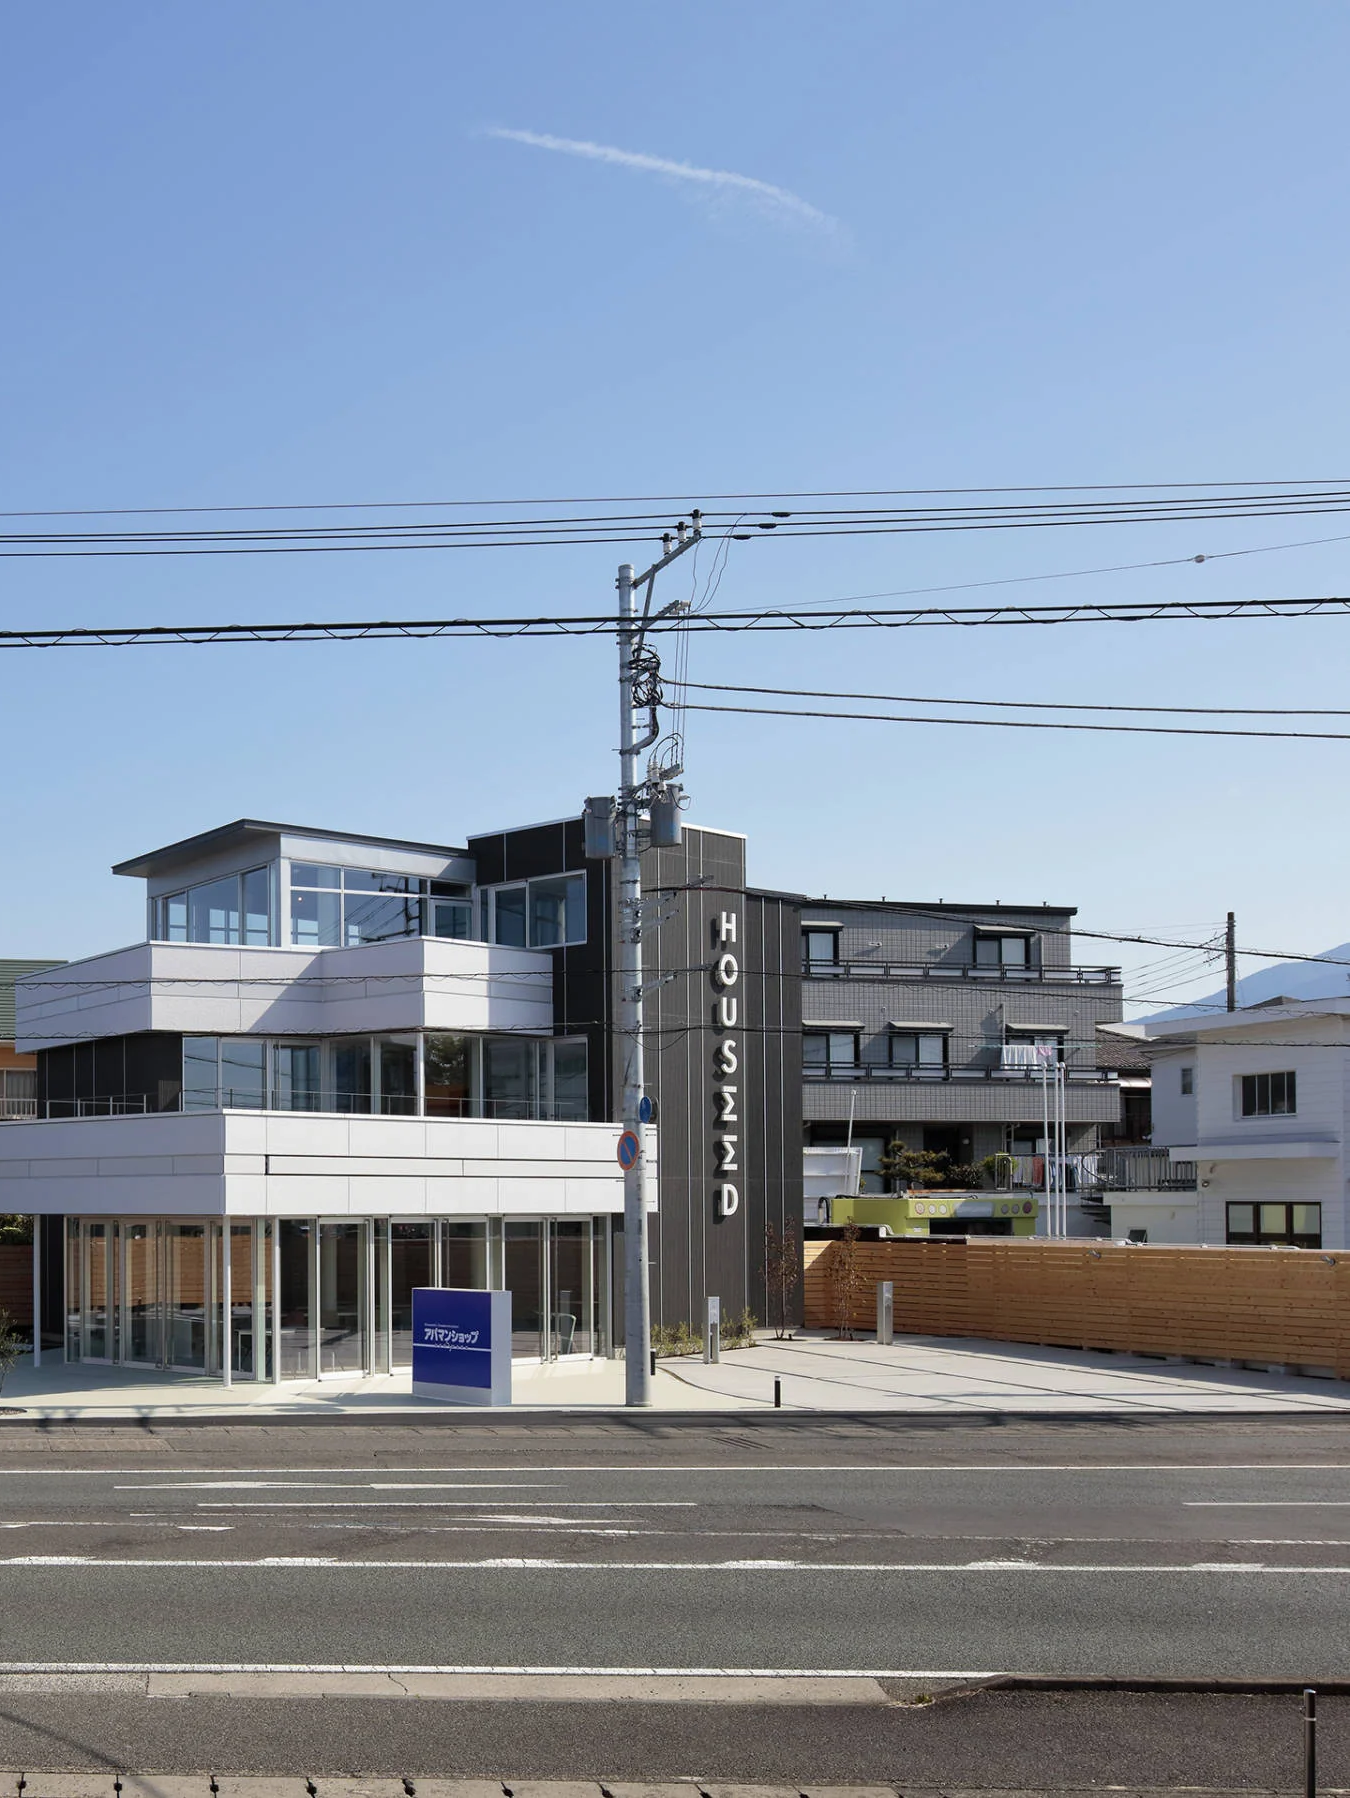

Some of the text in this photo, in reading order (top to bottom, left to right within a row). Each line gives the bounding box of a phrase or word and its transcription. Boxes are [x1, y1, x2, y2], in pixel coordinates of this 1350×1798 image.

[424, 1328, 479, 1343] アパマンショップ
